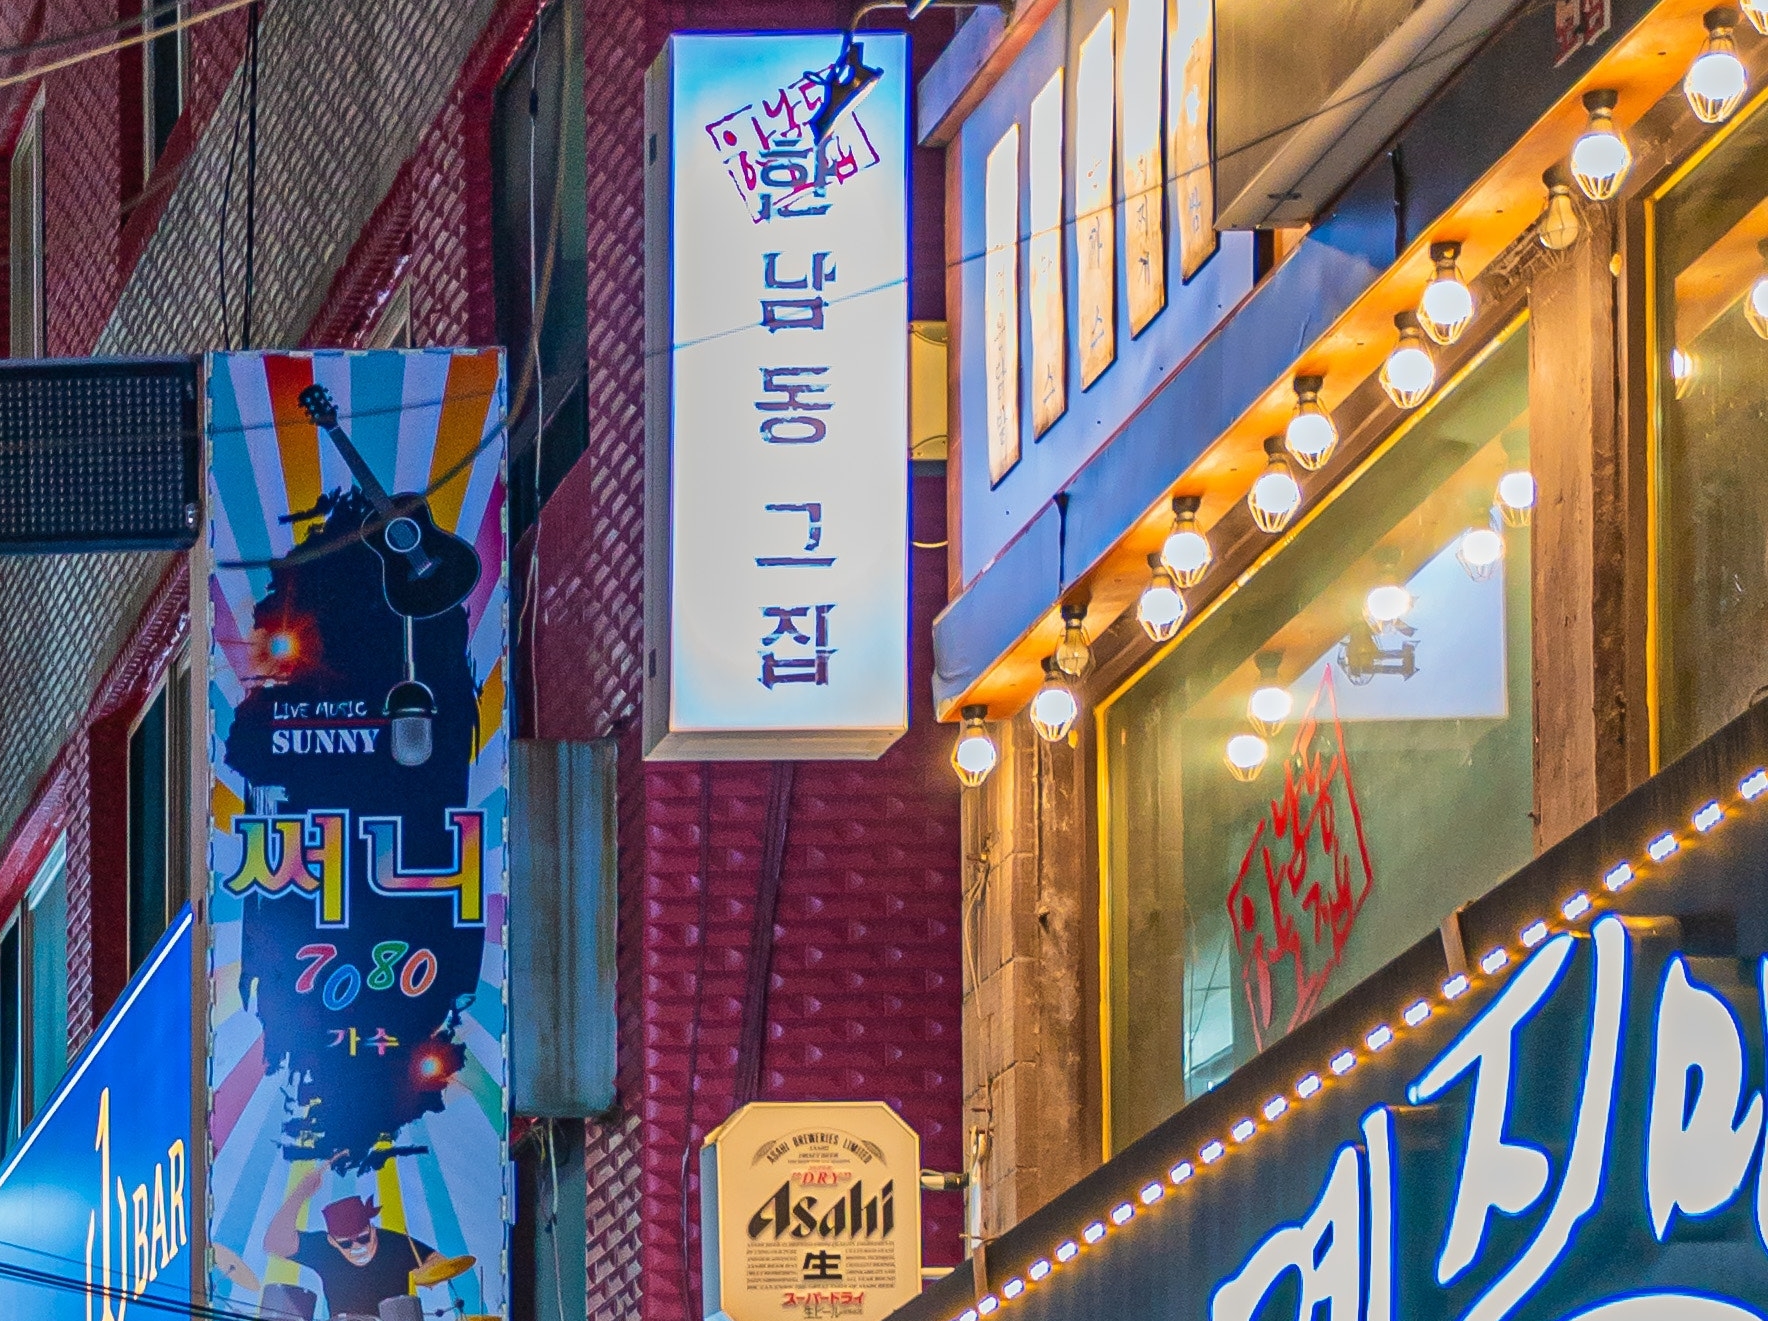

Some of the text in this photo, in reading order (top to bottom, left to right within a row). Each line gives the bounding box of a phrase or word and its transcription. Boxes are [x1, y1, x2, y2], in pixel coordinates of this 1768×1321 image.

[274, 701, 367, 719] LIVE MUSIC
[272, 729, 380, 754] SUNNY
[222, 808, 486, 928] 써니
[295, 940, 438, 1011] 7080
[327, 1026, 399, 1057] 가수
[767, 1132, 873, 1164] ASAHI BREWERIES LIMITED
[131, 1138, 188, 1303] BAR
[747, 1179, 894, 1239] Asahi
[802, 1250, 842, 1281] 生
[782, 1292, 865, 1306] スーパードライ
